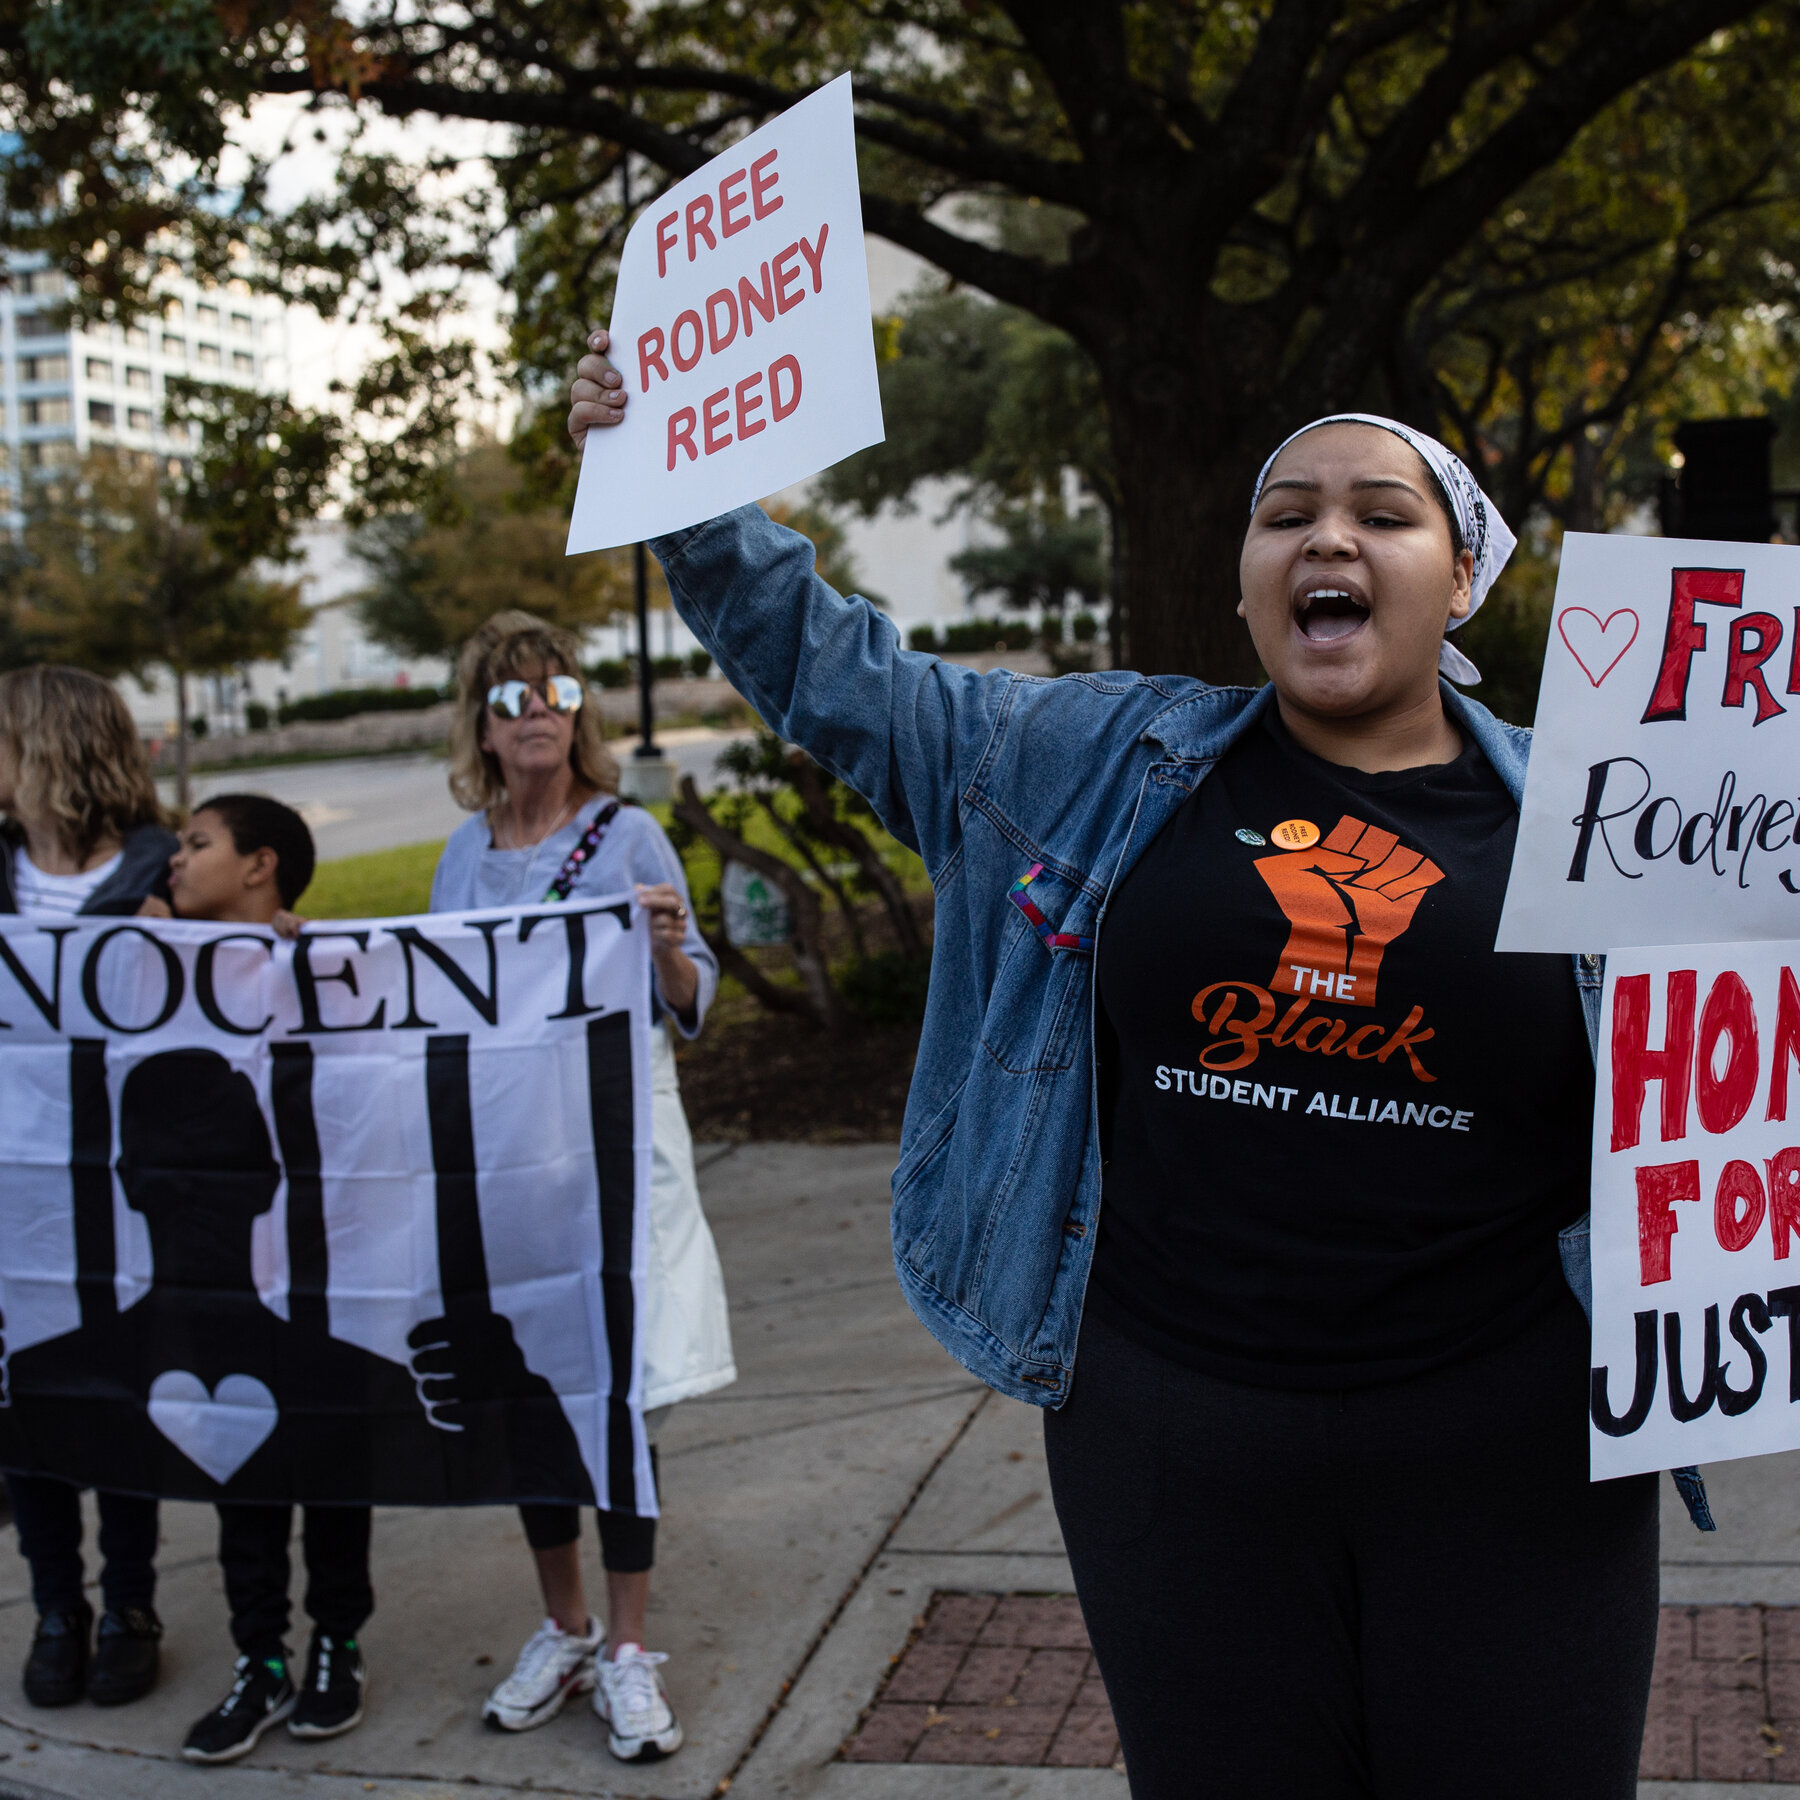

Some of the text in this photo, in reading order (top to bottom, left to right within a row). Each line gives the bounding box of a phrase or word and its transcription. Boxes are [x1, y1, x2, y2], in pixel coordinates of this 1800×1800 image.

[656, 148, 784, 279] FREE
[637, 223, 829, 393] RODNEY
[666, 353, 802, 472] REED
[0, 903, 632, 1035] NOCENT
[1290, 965, 1357, 1001] THE
[1191, 981, 1438, 1083] Black
[1154, 1065, 1475, 1132] STUDENT ALLIANCE
[1634, 1147, 1800, 1286] FOR
